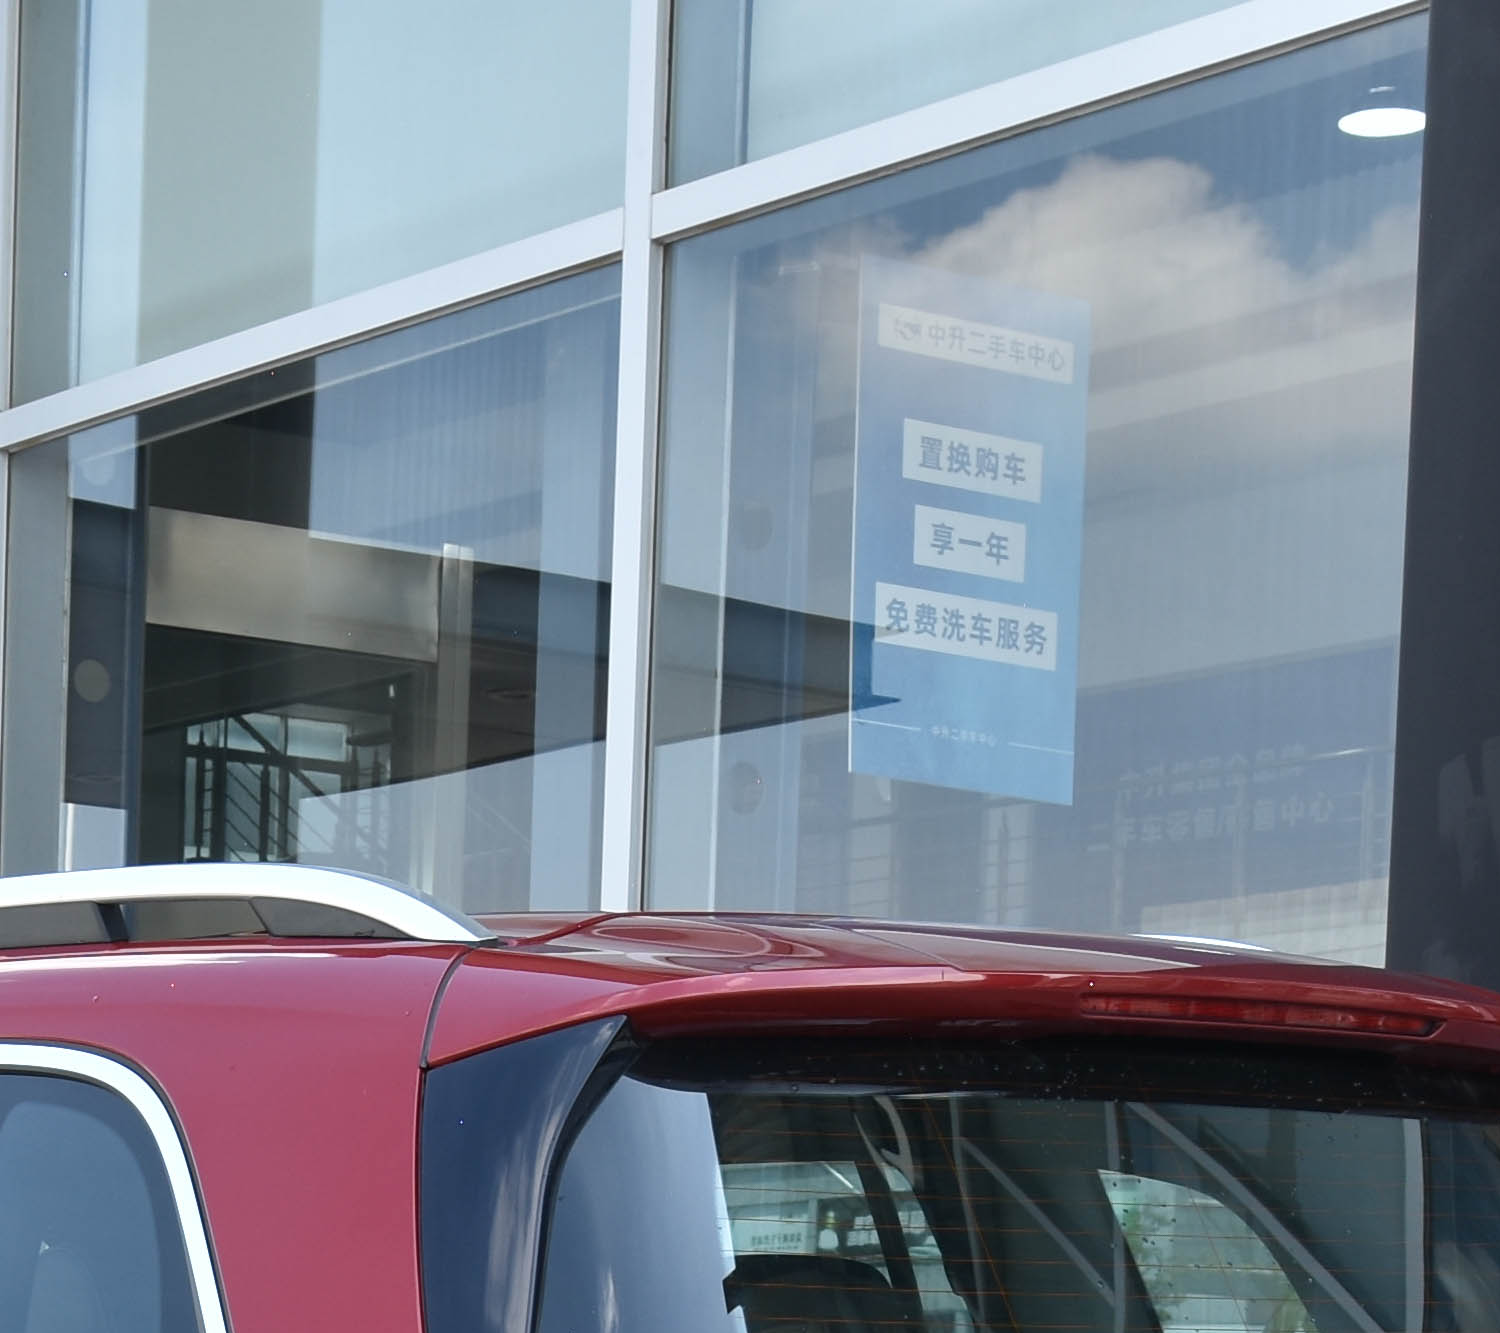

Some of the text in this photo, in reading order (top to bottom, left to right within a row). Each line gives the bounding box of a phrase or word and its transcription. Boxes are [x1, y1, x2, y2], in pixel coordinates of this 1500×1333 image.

[918, 436, 1028, 487] 置换购车
[930, 521, 1010, 566] 享一年
[885, 598, 1048, 656] 免费洗车服务
